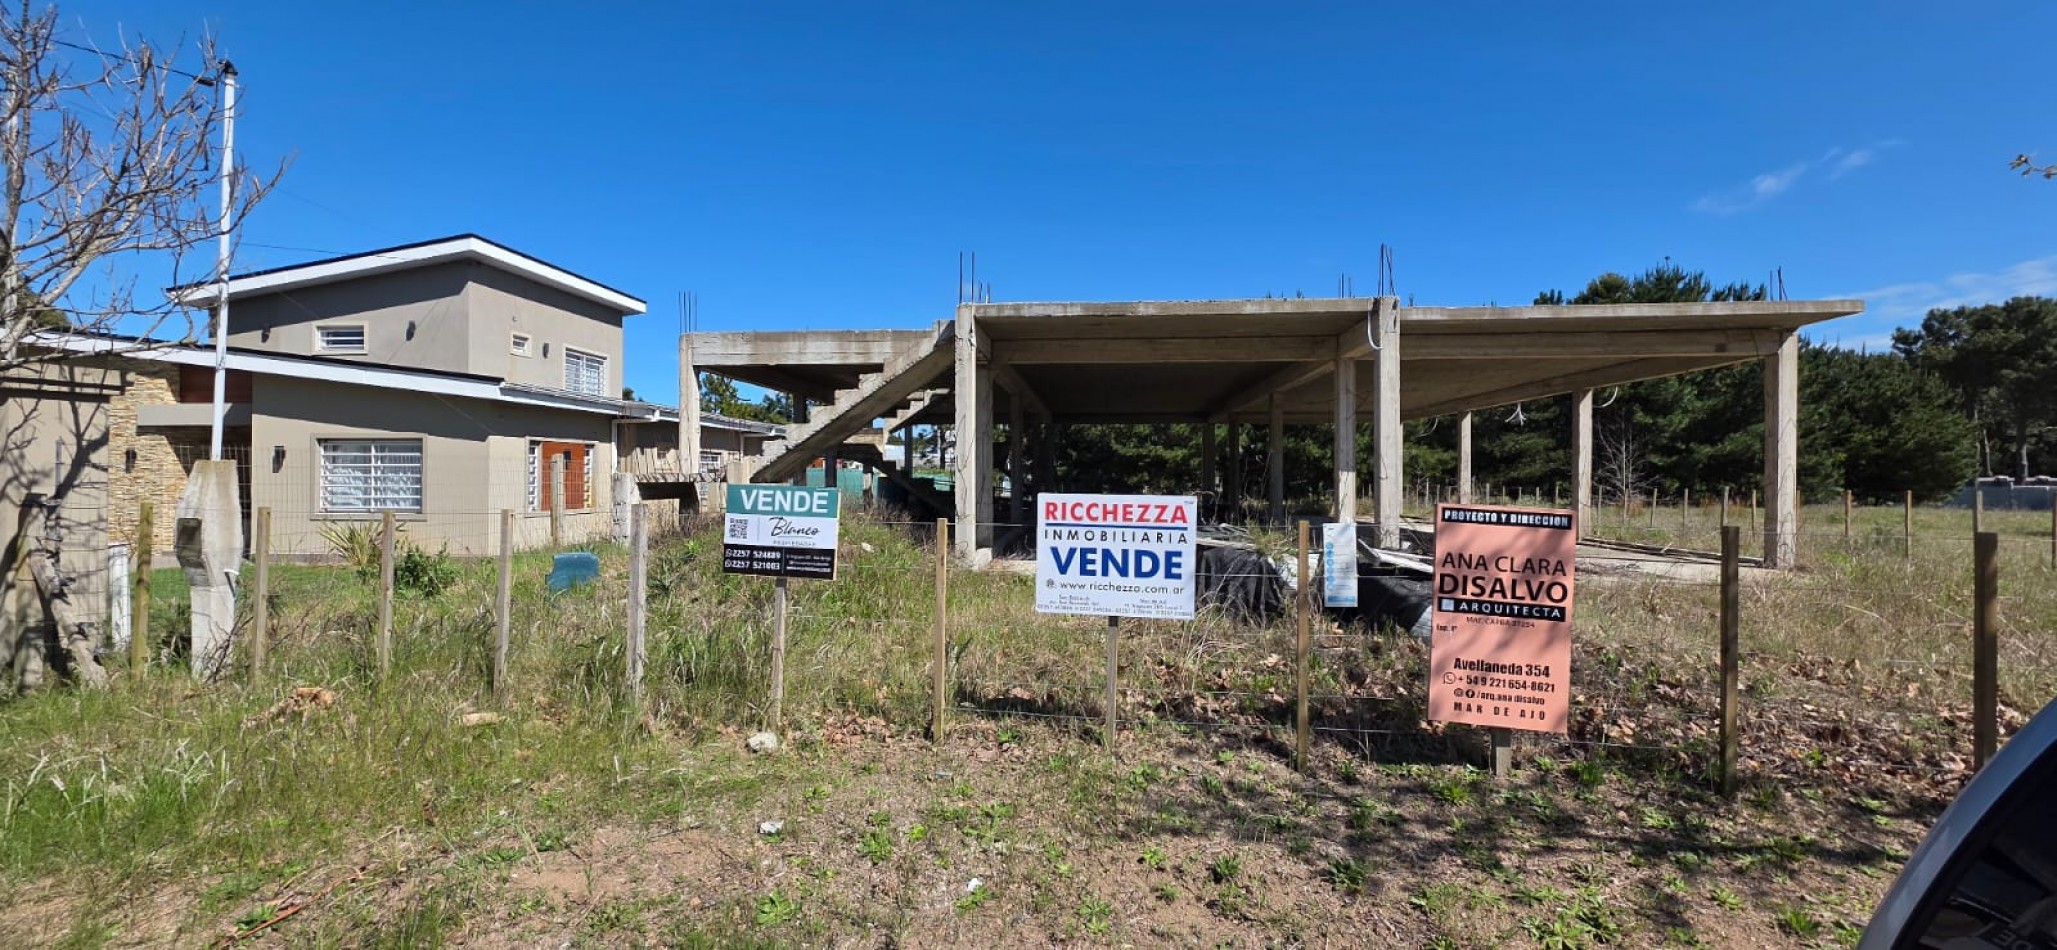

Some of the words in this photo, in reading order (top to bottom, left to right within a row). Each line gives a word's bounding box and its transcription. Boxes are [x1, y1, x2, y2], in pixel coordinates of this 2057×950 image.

[740, 489, 829, 513] VENDE
[1045, 502, 1188, 523] RICCHEZZA
[1444, 509, 1498, 523] PROYECTO
[1501, 513, 1508, 524] Y
[768, 516, 821, 537] Blanco
[1044, 529, 1188, 544] INMOBILIARIA
[1050, 547, 1183, 580] VENDE
[1442, 552, 1488, 572] ANA
[1494, 556, 1567, 577] CLARA
[1438, 573, 1568, 604] DISALVO
[1459, 601, 1561, 618] ARQUITECTA
[1453, 657, 1523, 676] Avellaneda
[1525, 663, 1550, 678] 354
[1466, 674, 1478, 686] 54
[1480, 676, 1487, 686] 9
[1489, 677, 1506, 688] 221
[1508, 679, 1556, 693] 654-8621
[1453, 702, 1483, 713] MAR
[1494, 706, 1510, 716] DE
[1520, 709, 1546, 720] AJO
